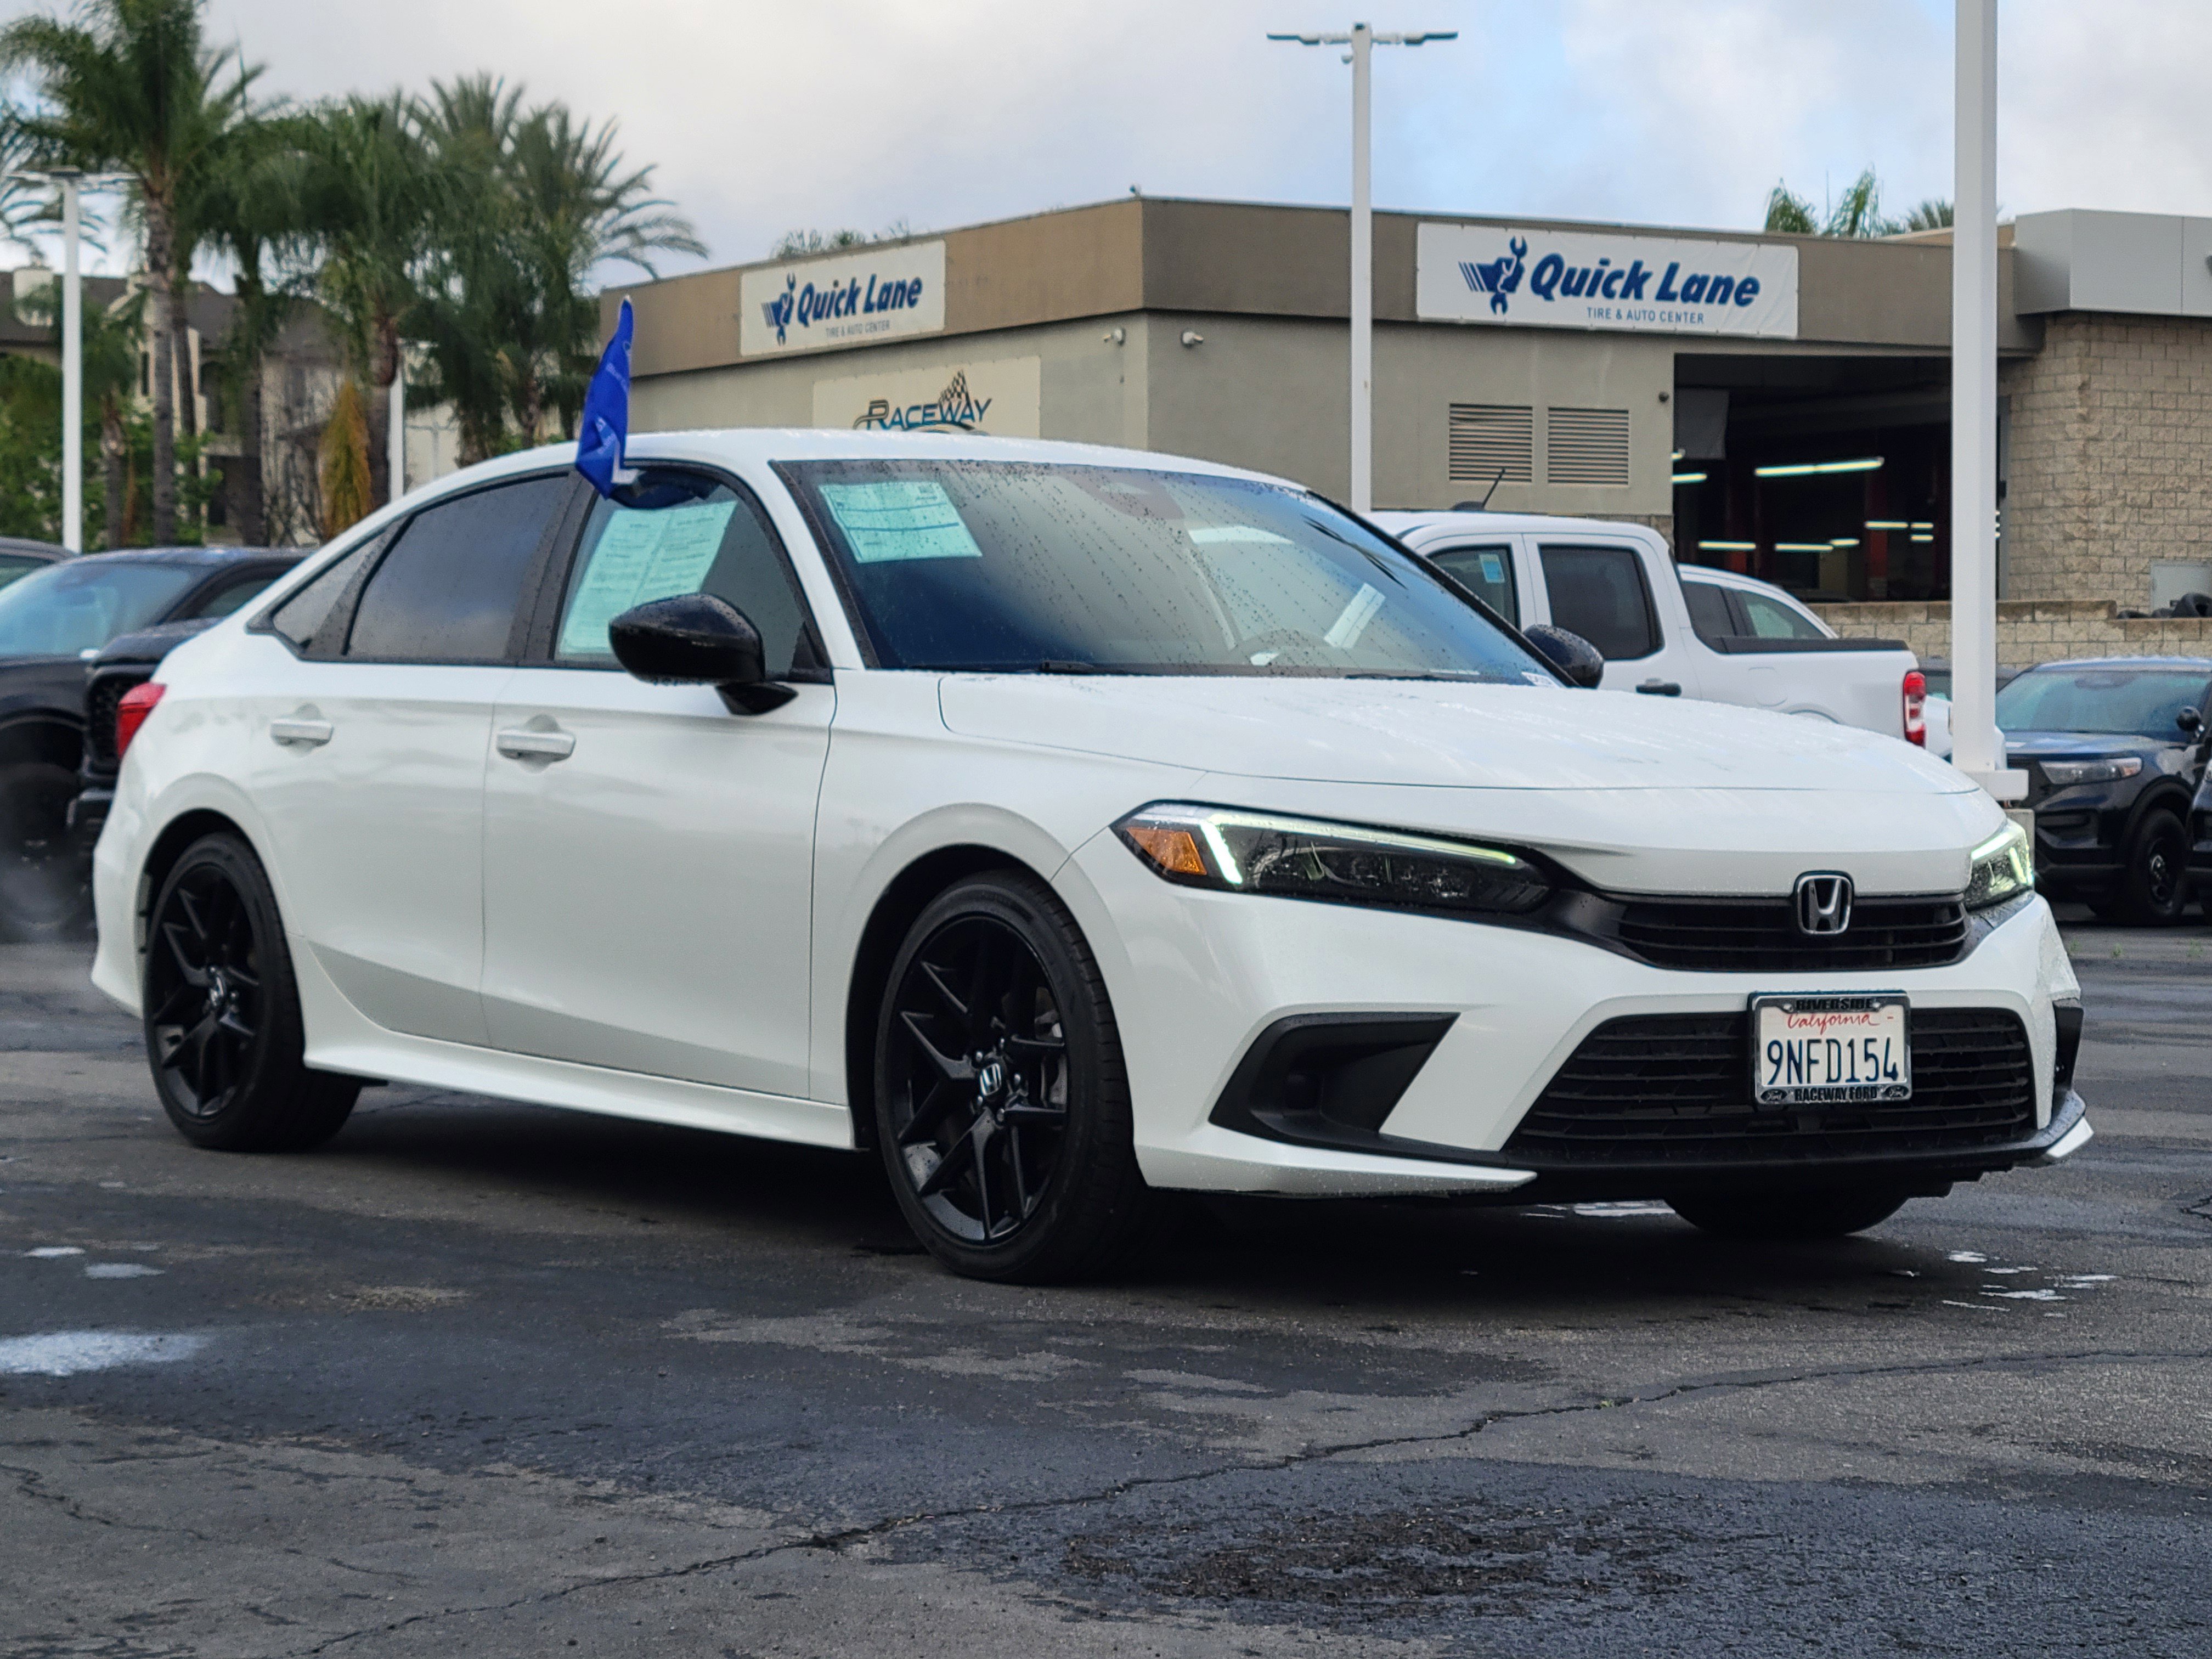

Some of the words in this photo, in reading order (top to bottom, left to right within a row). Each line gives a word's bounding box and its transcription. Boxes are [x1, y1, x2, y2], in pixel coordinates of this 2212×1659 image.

[1530, 253, 1653, 301] Quick
[1655, 262, 1760, 307] Lane
[798, 276, 862, 328] Quick
[863, 273, 923, 314] Lane
[1587, 307, 1611, 319] TIRE
[1616, 308, 1622, 320] &
[1627, 309, 1655, 321] AUTO
[1660, 311, 1704, 324] CENTER
[853, 398, 992, 430] RACEWAY
[1796, 998, 1873, 1010] RIVERSIDE
[1787, 1013, 1880, 1035] California
[1767, 1037, 1899, 1085] 9NFD154
[1795, 1087, 1848, 1101] RACEWAY
[1849, 1086, 1878, 1099] FORD
